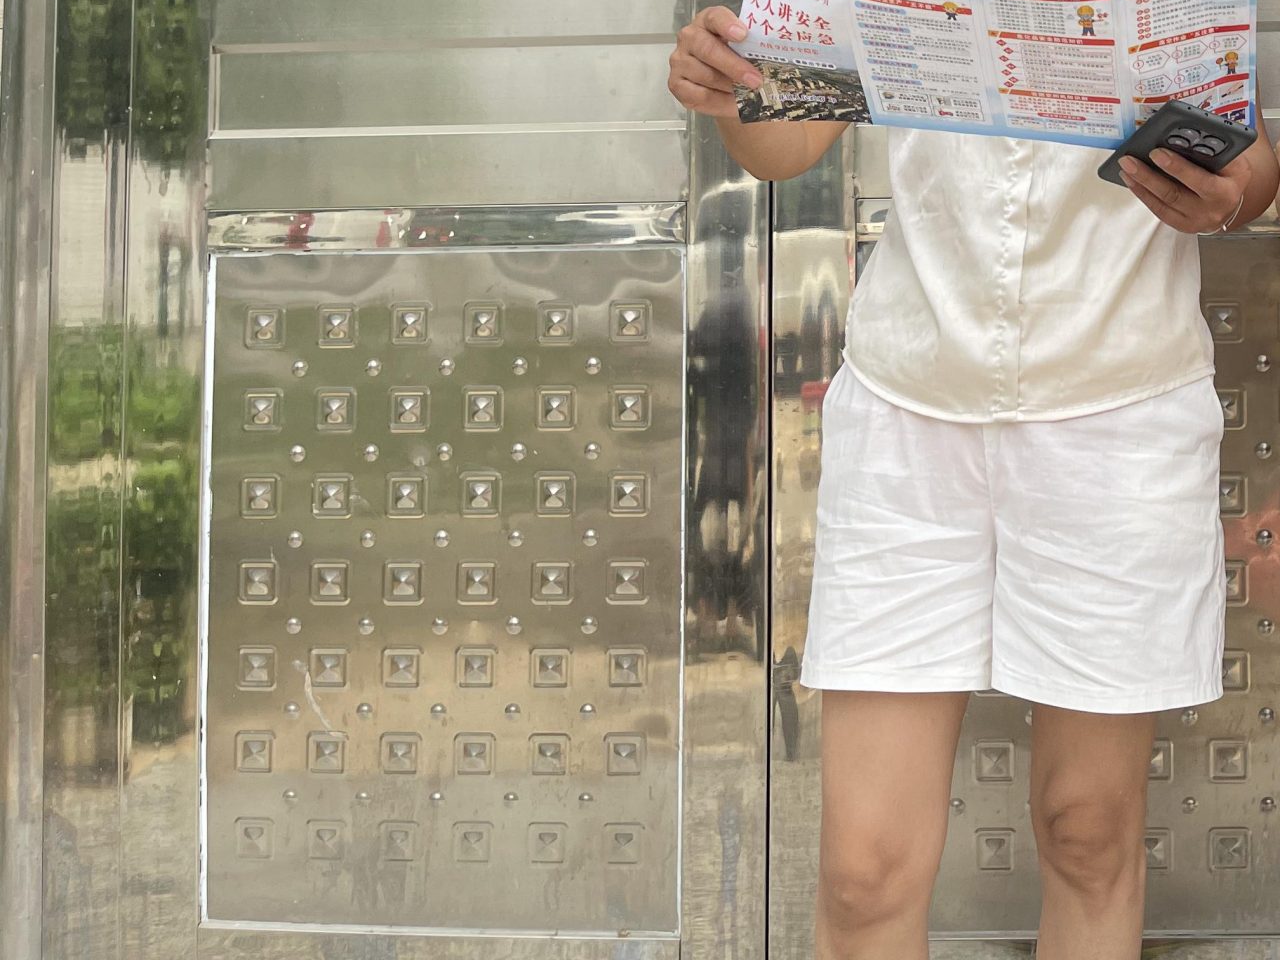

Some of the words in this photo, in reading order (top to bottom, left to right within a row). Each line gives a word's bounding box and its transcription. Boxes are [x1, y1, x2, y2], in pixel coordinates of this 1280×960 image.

[746, 12, 835, 46] 个个会应急
